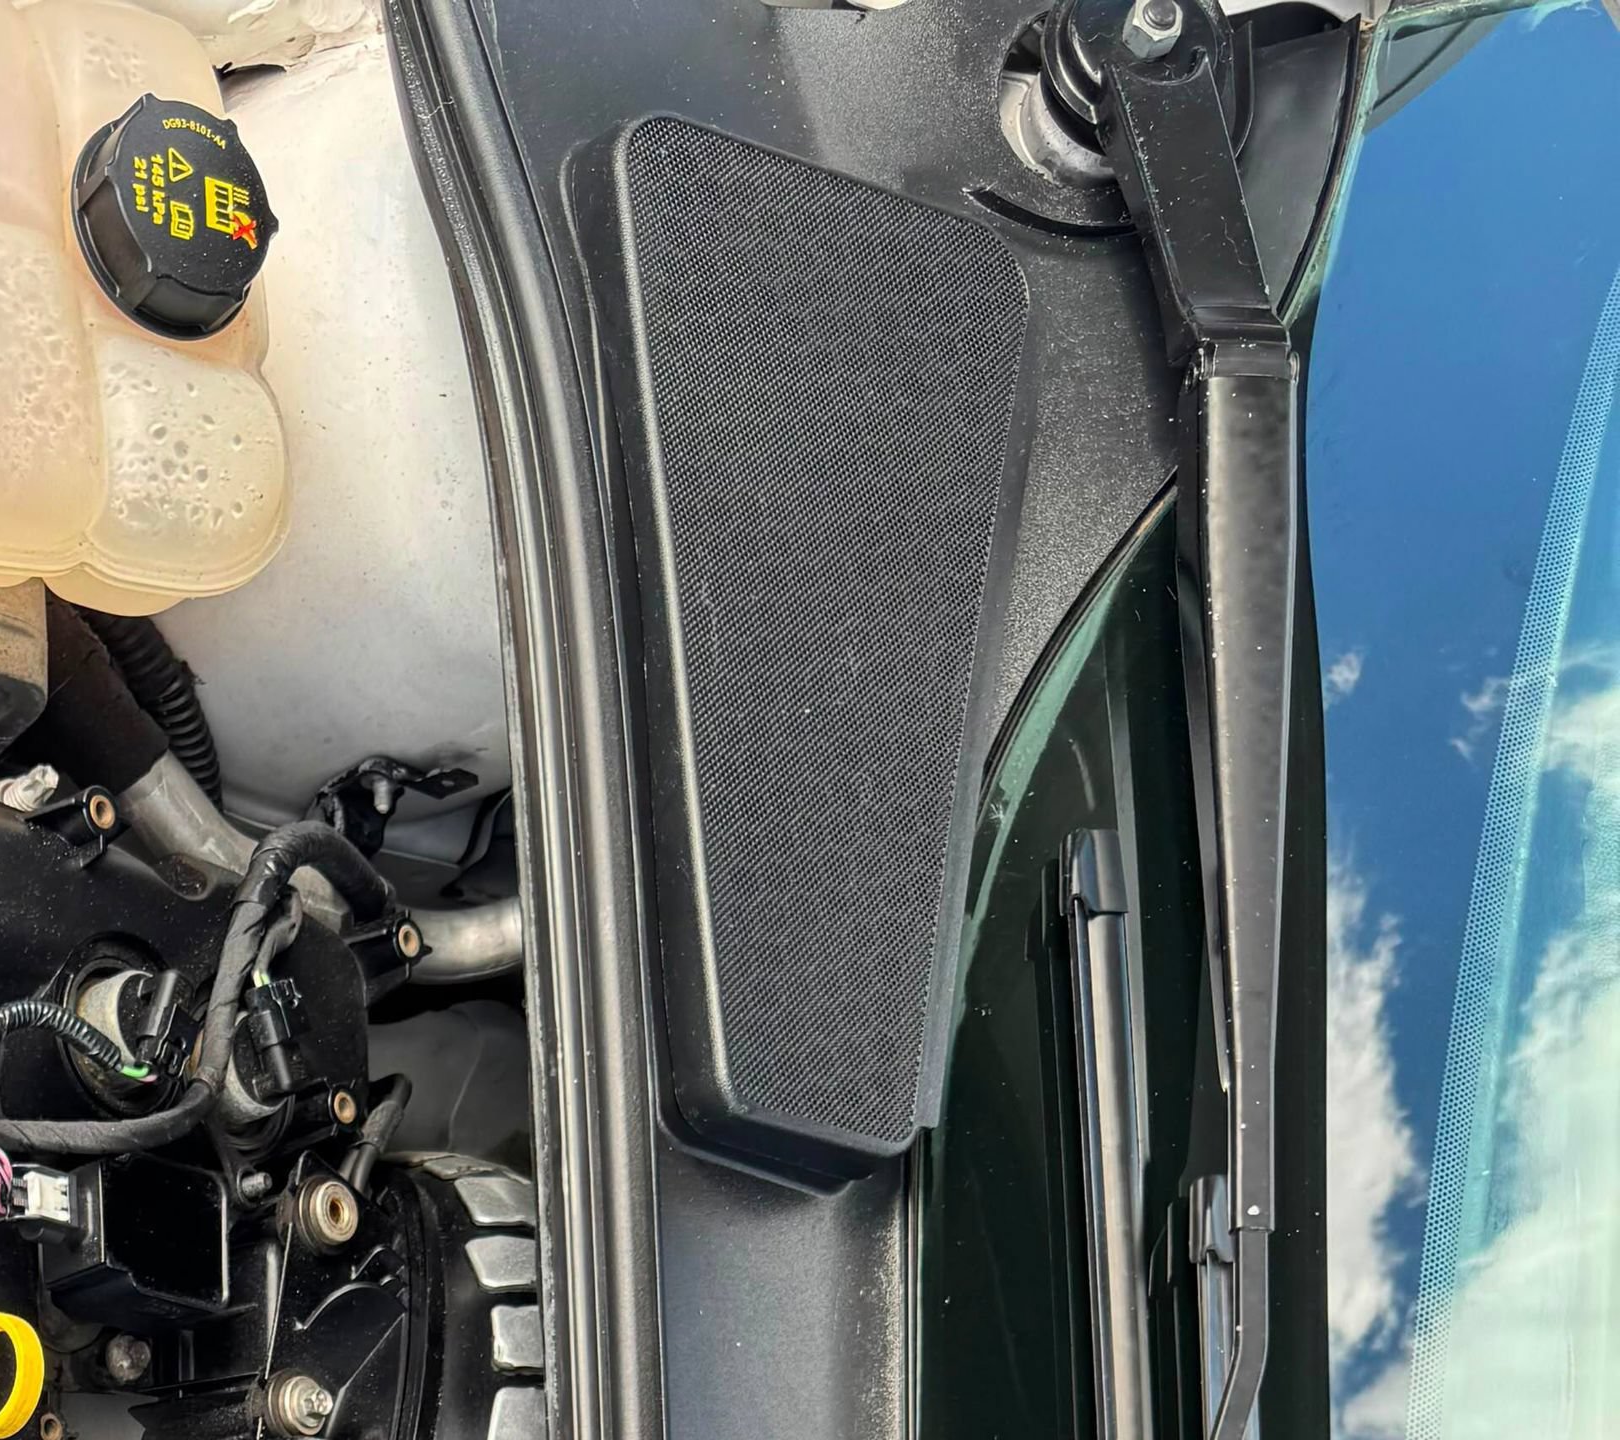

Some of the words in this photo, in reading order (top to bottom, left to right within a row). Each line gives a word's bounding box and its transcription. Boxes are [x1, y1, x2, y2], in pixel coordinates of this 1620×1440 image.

[161, 118, 227, 150] DG93-8101-AA
[133, 156, 148, 180] 21
[150, 153, 165, 187] 145
[132, 182, 149, 213] psi
[152, 189, 166, 225] kPa
